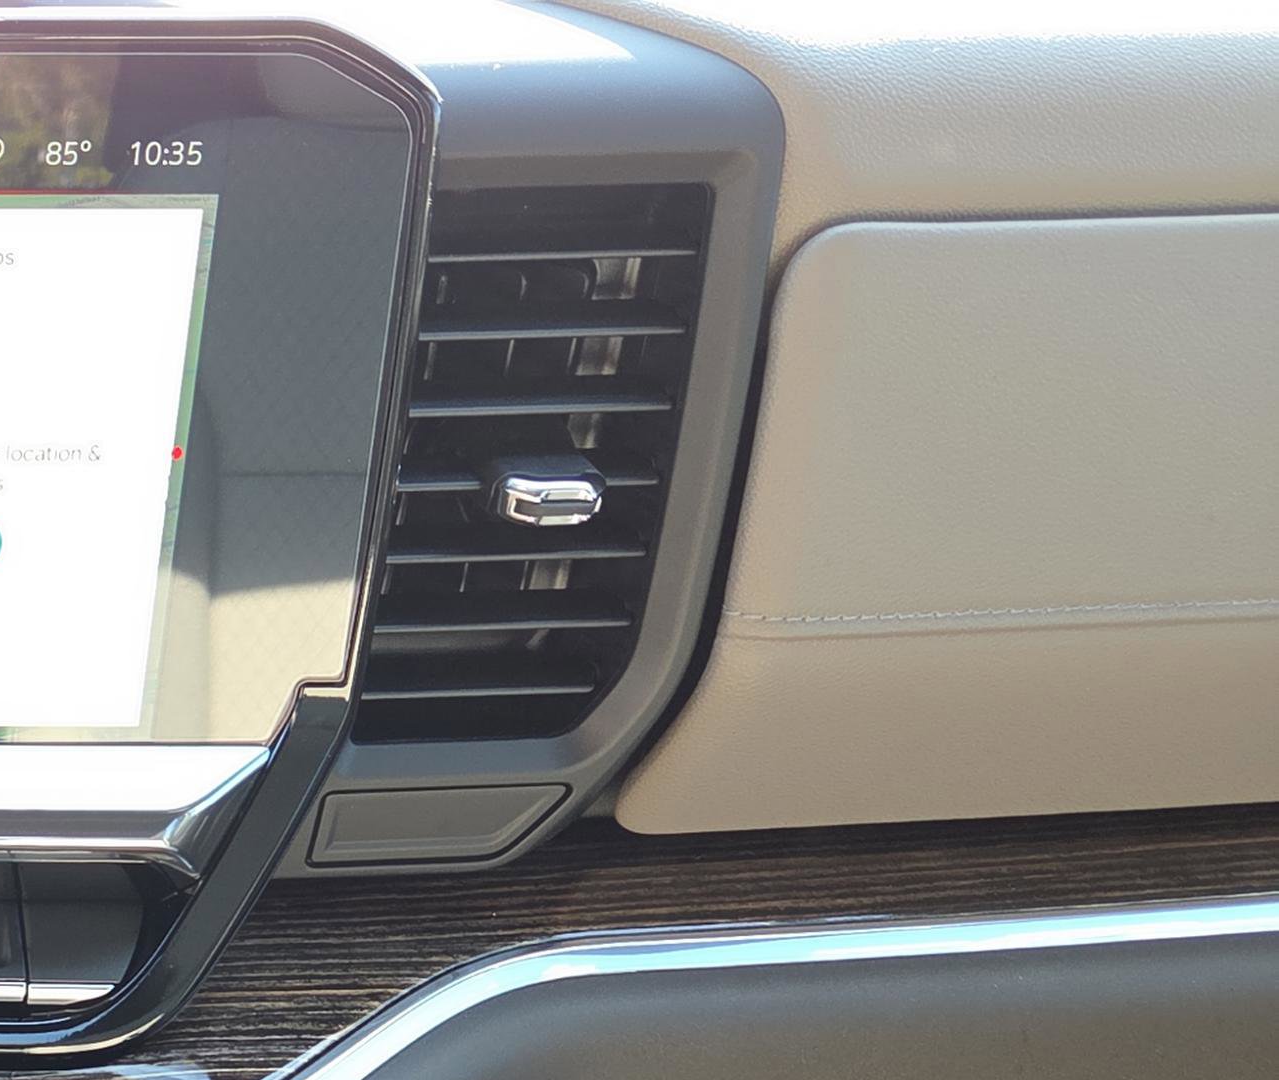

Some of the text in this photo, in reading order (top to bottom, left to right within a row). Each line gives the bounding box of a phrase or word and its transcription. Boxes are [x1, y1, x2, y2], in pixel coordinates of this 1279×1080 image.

[130, 140, 204, 166] 10:35
[5, 444, 81, 463] location
[87, 444, 101, 463] &
